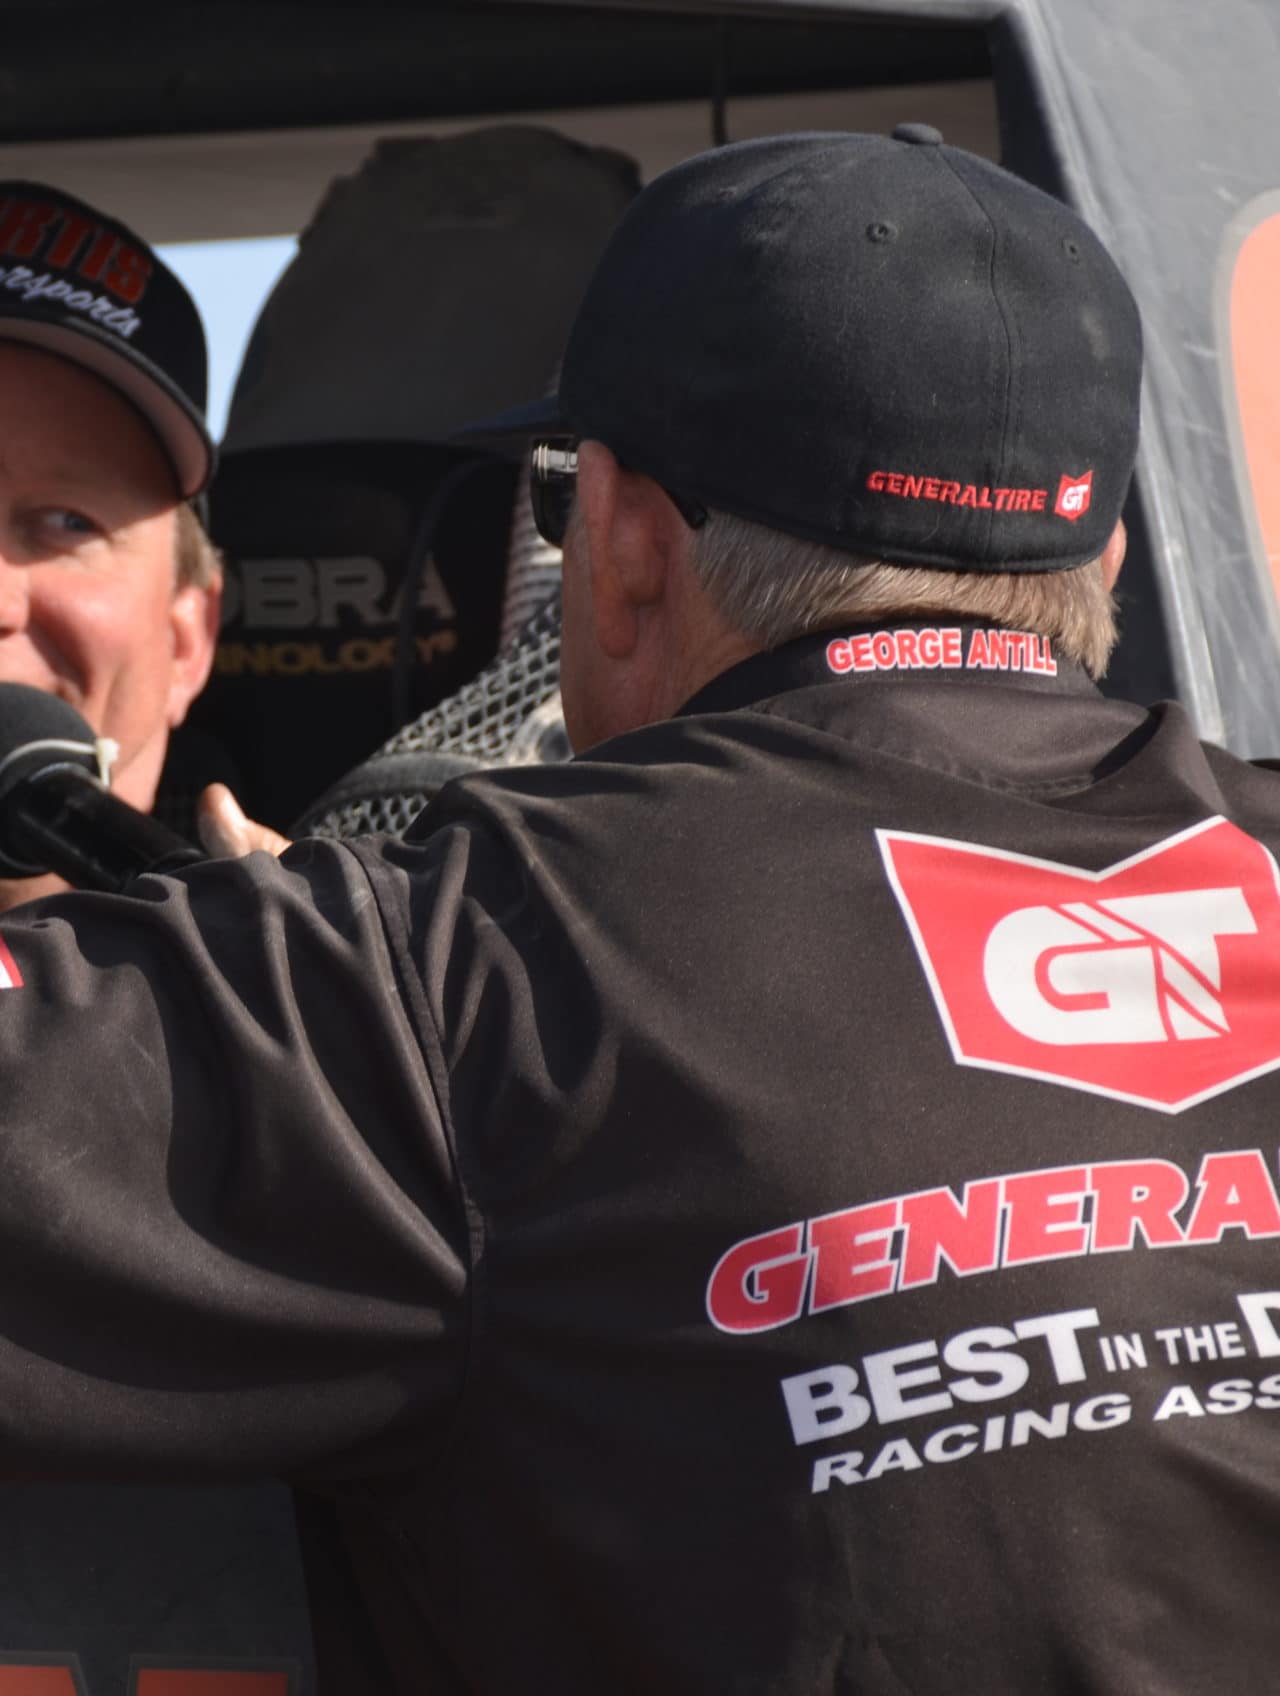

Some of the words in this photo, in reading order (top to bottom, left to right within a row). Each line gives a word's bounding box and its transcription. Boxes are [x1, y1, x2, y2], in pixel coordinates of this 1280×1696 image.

[220, 552, 456, 629] BRA
[826, 628, 962, 674] GEORGE
[966, 629, 1058, 677] ANTILL
[983, 886, 1259, 1047] GT
[706, 1148, 1280, 1335] GENERA
[780, 1308, 1100, 1446] BEST
[1098, 1332, 1149, 1374] IN
[1155, 1321, 1247, 1367] THE
[811, 1392, 1133, 1494] RACING
